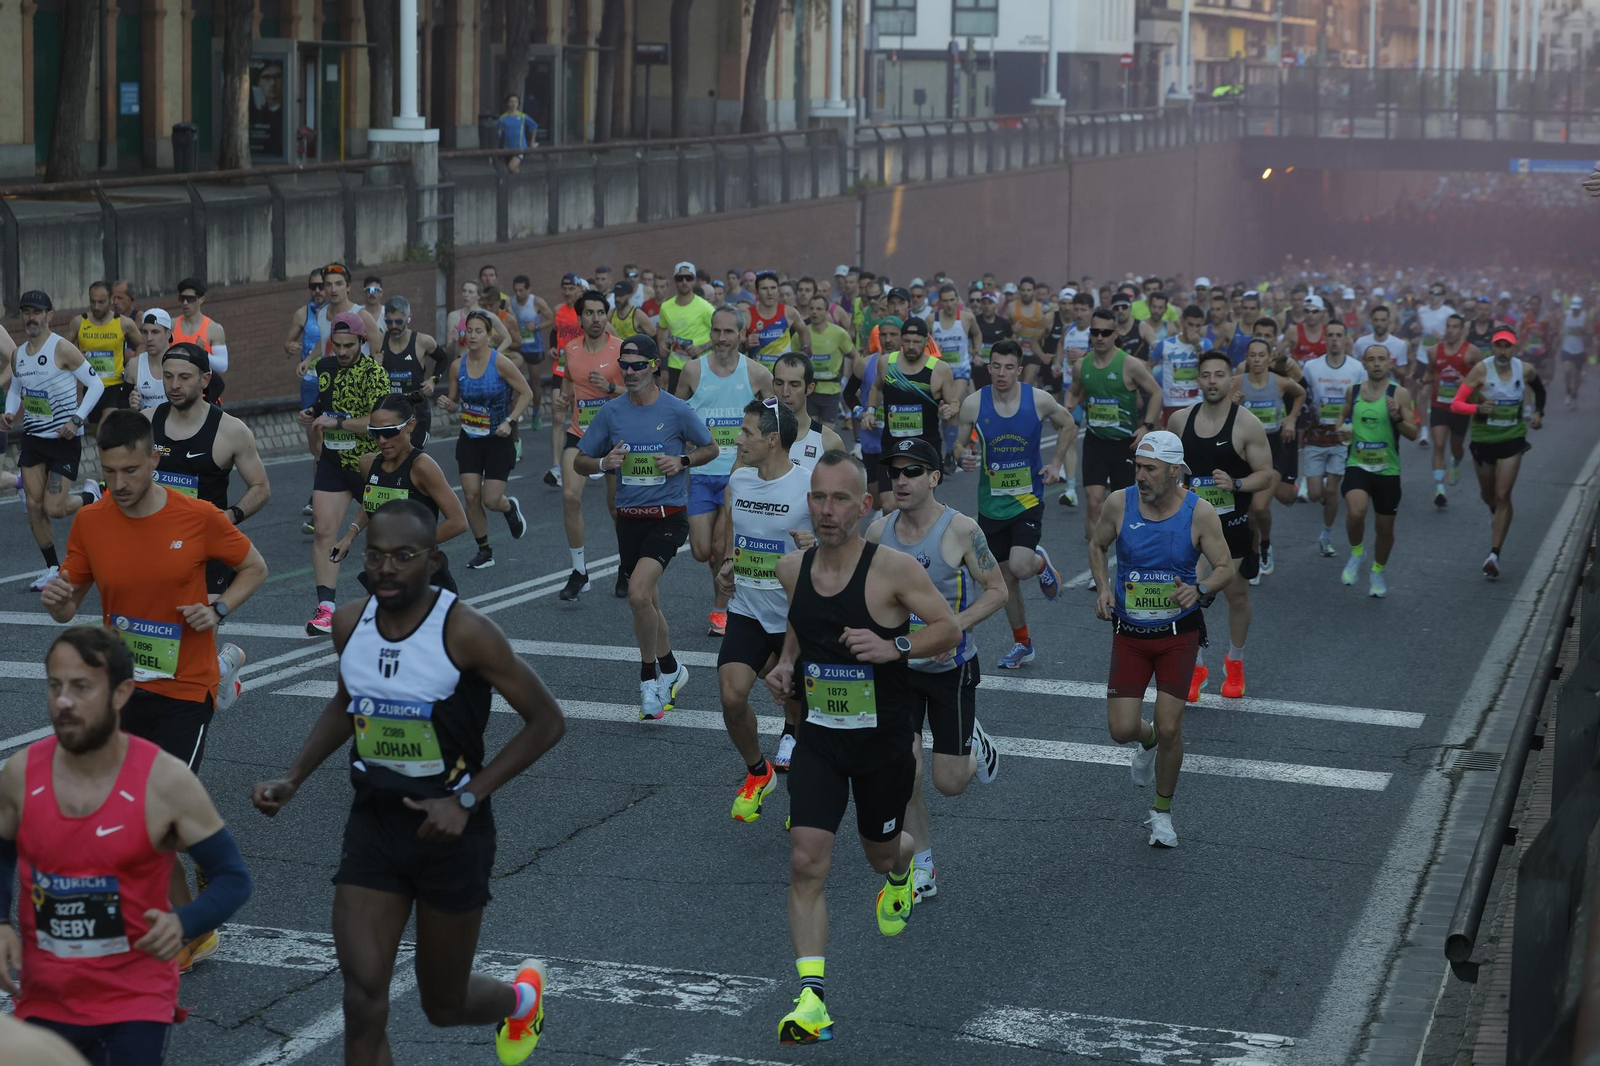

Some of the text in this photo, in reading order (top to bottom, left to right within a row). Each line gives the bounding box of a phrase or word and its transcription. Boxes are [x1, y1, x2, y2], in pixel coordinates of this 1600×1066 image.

[631, 466, 653, 475] JUAN
[1002, 461, 1026, 469] ZURICH
[161, 474, 193, 485] ZURICH
[1001, 479, 1021, 488] ALEX
[377, 491, 390, 500] 2113
[620, 507, 660, 515] WONG
[735, 498, 790, 513] MONSANTO
[749, 540, 778, 550] ZURICH
[749, 556, 764, 564] 1471
[1143, 573, 1174, 581] ZURICH
[1135, 597, 1171, 608] ARILLO
[132, 622, 173, 636] ZURICH
[1121, 623, 1170, 634] WONG
[133, 640, 153, 652] 1896
[380, 647, 401, 659] SCUF
[824, 668, 864, 678] ZURICH
[827, 687, 848, 696] 1873
[378, 703, 421, 717] ZURICH
[827, 699, 850, 713] RIK
[373, 741, 422, 758] JOHAN
[52, 877, 107, 891] ZURICH
[54, 901, 86, 916] 3272
[49, 918, 97, 938] SEBY
